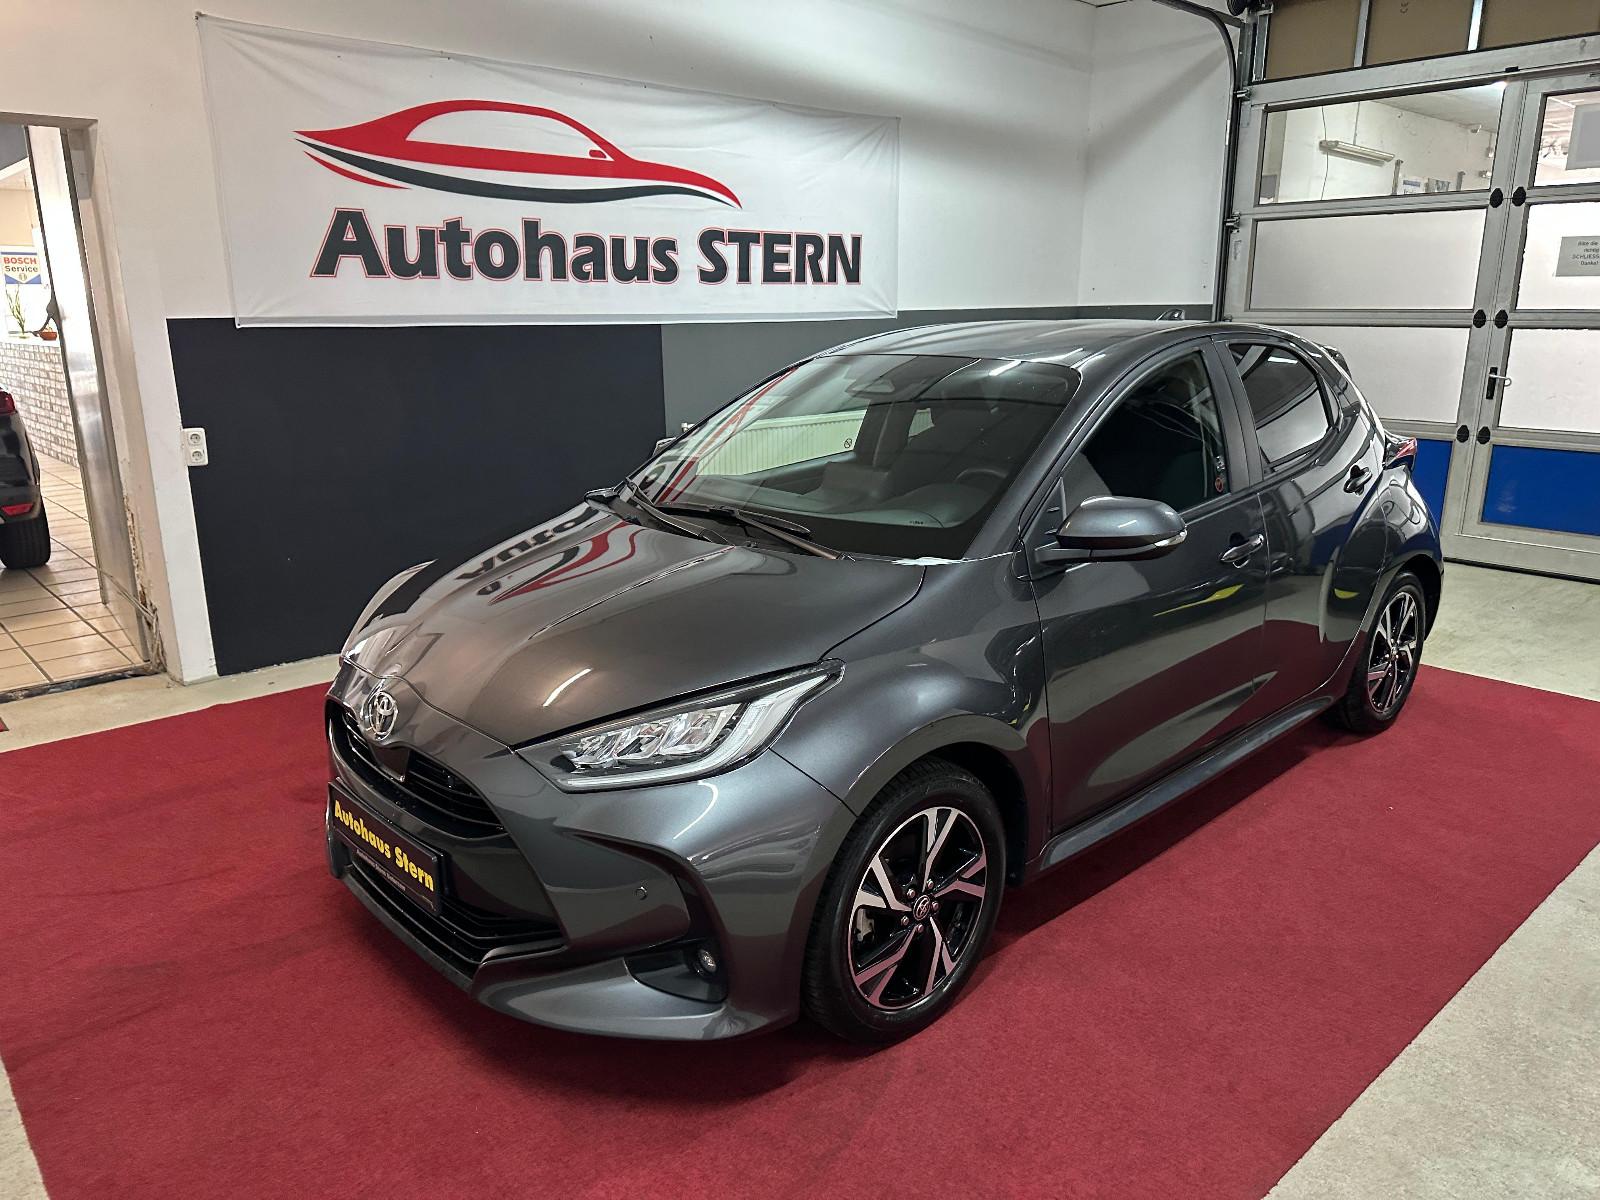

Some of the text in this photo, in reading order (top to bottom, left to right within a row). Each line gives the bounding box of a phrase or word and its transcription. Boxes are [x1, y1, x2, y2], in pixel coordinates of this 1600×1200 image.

[310, 207, 862, 285] Autohaus STERN
[334, 800, 391, 859] Autohaus
[394, 846, 434, 891] Stern
